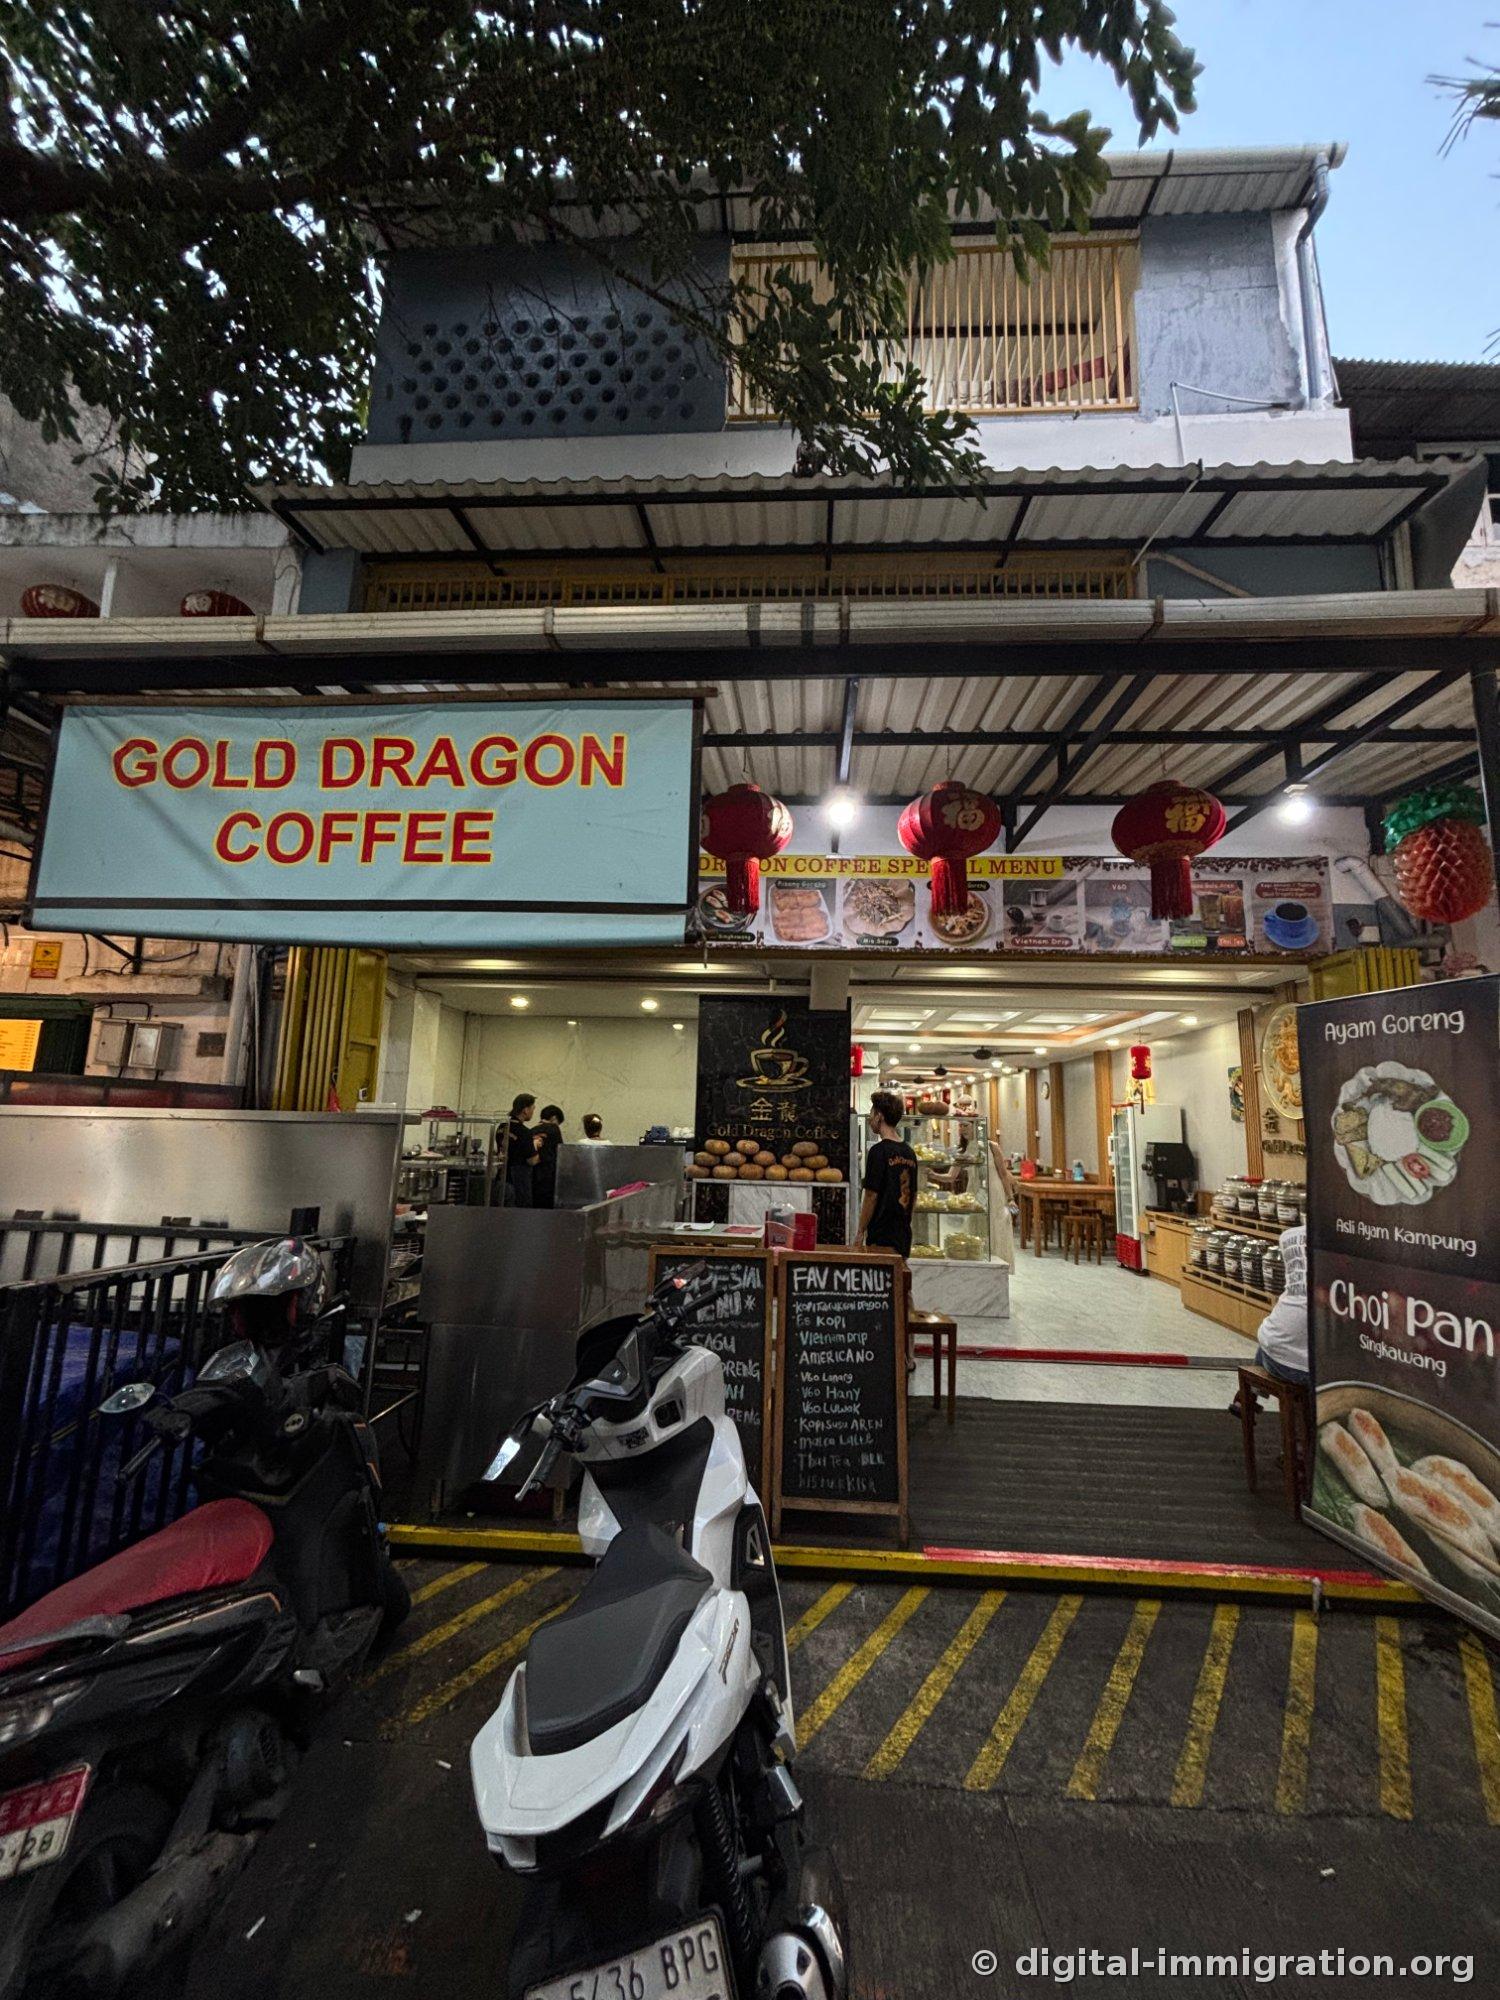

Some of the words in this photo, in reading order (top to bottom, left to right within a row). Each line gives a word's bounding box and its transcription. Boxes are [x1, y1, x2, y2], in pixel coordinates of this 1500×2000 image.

[112, 736, 297, 790] GOLD
[319, 733, 627, 788] DRAGON
[214, 810, 497, 865] COFFEE
[697, 856, 787, 872] DRON
[794, 857, 882, 873] COFFEE
[988, 859, 1057, 875] MENU
[1014, 937, 1049, 945] Vietnam
[1051, 937, 1070, 947] Drip
[1325, 1017, 1376, 1045] Ayam
[1382, 1010, 1465, 1037] Goreng
[706, 1122, 740, 1137] Gold
[740, 1123, 792, 1141] Dragon
[1336, 1218, 1356, 1237] Asli
[1357, 1221, 1390, 1242] Ayam
[1394, 1227, 1477, 1257] Kampung
[793, 1266, 829, 1292] FAV
[1329, 1279, 1390, 1331] Choi
[1359, 1333, 1448, 1378] Singkawang
[660, 1928, 719, 1990] BPG
